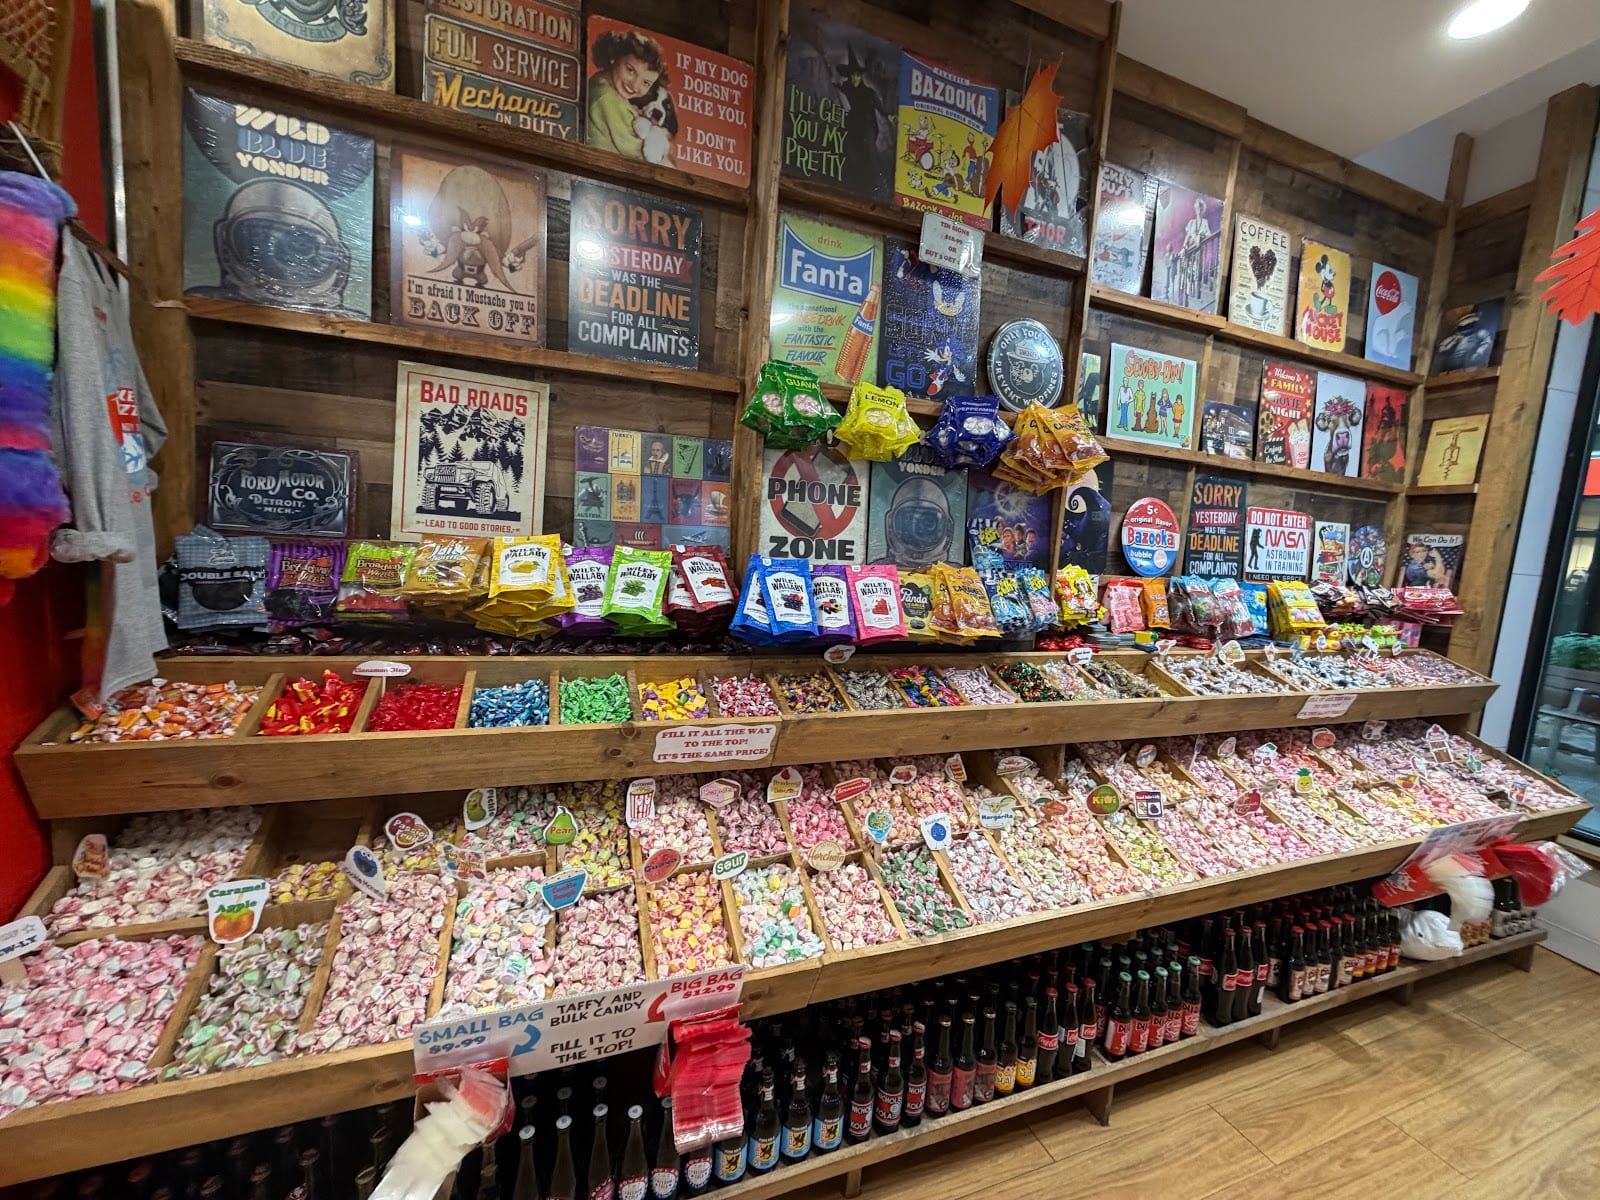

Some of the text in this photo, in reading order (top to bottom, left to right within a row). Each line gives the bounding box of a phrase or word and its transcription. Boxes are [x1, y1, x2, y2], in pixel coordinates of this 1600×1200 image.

[434, 24, 571, 90] FULL SERVICE
[676, 52, 748, 88] IF MY DOG
[432, 70, 562, 119] Mechanic
[683, 74, 742, 104] DOESN'T
[911, 68, 987, 122] BAZOOKA
[677, 93, 748, 129] LIKE YOU,
[789, 84, 849, 129] I'LL GET
[235, 103, 331, 145] WILD
[495, 113, 573, 140] ON DUTY
[789, 113, 848, 154] YOU MY
[686, 126, 737, 153] I DON'T
[235, 151, 330, 186] YONDER
[676, 143, 746, 177] LIKE YOU.
[785, 136, 847, 182] PRETTY
[581, 192, 692, 250] SORRY
[817, 235, 842, 249] drink
[1240, 221, 1287, 249] COFFEE
[611, 269, 662, 289] WAS THE
[789, 247, 864, 296] Fanta
[408, 279, 536, 313] I'm afraid I Mustache you to
[578, 276, 691, 322] DEADLINE
[407, 296, 536, 336] BACK OFF
[611, 311, 658, 331] FOR ALL
[854, 315, 874, 333] Fanta
[577, 320, 691, 358] COMPLAINTS
[813, 325, 824, 333] the
[1000, 328, 1020, 350] ONLY
[783, 333, 836, 347] FANTASTIC
[785, 350, 829, 365] FLAVOUR
[785, 378, 818, 390] GUAVA
[886, 359, 927, 389] GO
[994, 360, 1021, 404] PREVENT
[1270, 378, 1306, 394] FAMILY
[420, 380, 529, 417] BAD ROADS
[864, 394, 899, 409] LEMON
[1269, 405, 1301, 420] NIGHT
[1263, 445, 1283, 455] Enjoy
[271, 468, 326, 493] MOTOR
[767, 477, 862, 508] PHONE
[1193, 482, 1242, 508] SORRY
[425, 519, 514, 534] LEAD TO GOOD STORIES.
[1130, 516, 1153, 524] original
[1195, 511, 1238, 524] YESTERDAY
[1251, 511, 1307, 529] DO NOT ENTER
[1127, 526, 1176, 547] Bazooka
[1204, 526, 1227, 535] WAS THE
[1264, 528, 1307, 550] NASA
[1412, 535, 1448, 545] We Can Do
[769, 535, 855, 562] ZONE
[1190, 533, 1240, 553] DEADLINE
[504, 551, 548, 561] WALLABY
[1130, 549, 1153, 559] bubble
[1203, 551, 1224, 561] FOR ALL
[1265, 549, 1304, 562] ASTRONAUT
[357, 559, 404, 571] Broadway
[688, 565, 722, 575] WALLABY
[1189, 560, 1239, 576] COMPLAINTS
[1265, 562, 1304, 573] IN TRAINING
[568, 572, 606, 582] WALLABY
[620, 571, 658, 581] WALLABY
[770, 581, 805, 593] WALLABY
[813, 587, 844, 596] WALLABY
[860, 587, 893, 596] WALLABY
[900, 588, 928, 604] Panda
[661, 727, 772, 739] FILL IT ALL THE WAY
[725, 738, 749, 746] TOP!
[657, 748, 769, 761] IT'S THE SAME PRICE!
[549, 826, 574, 835] Pear
[208, 881, 267, 899] Caramel
[214, 899, 258, 914] Apple
[670, 967, 744, 994] BIG BAG
[556, 990, 642, 1015] TAFFY AND
[549, 999, 646, 1028] BULK CANDY
[418, 1008, 544, 1046] SMALL BAG
[549, 1027, 637, 1054] FILL IT TO
[555, 1038, 634, 1064] THE TOP!
